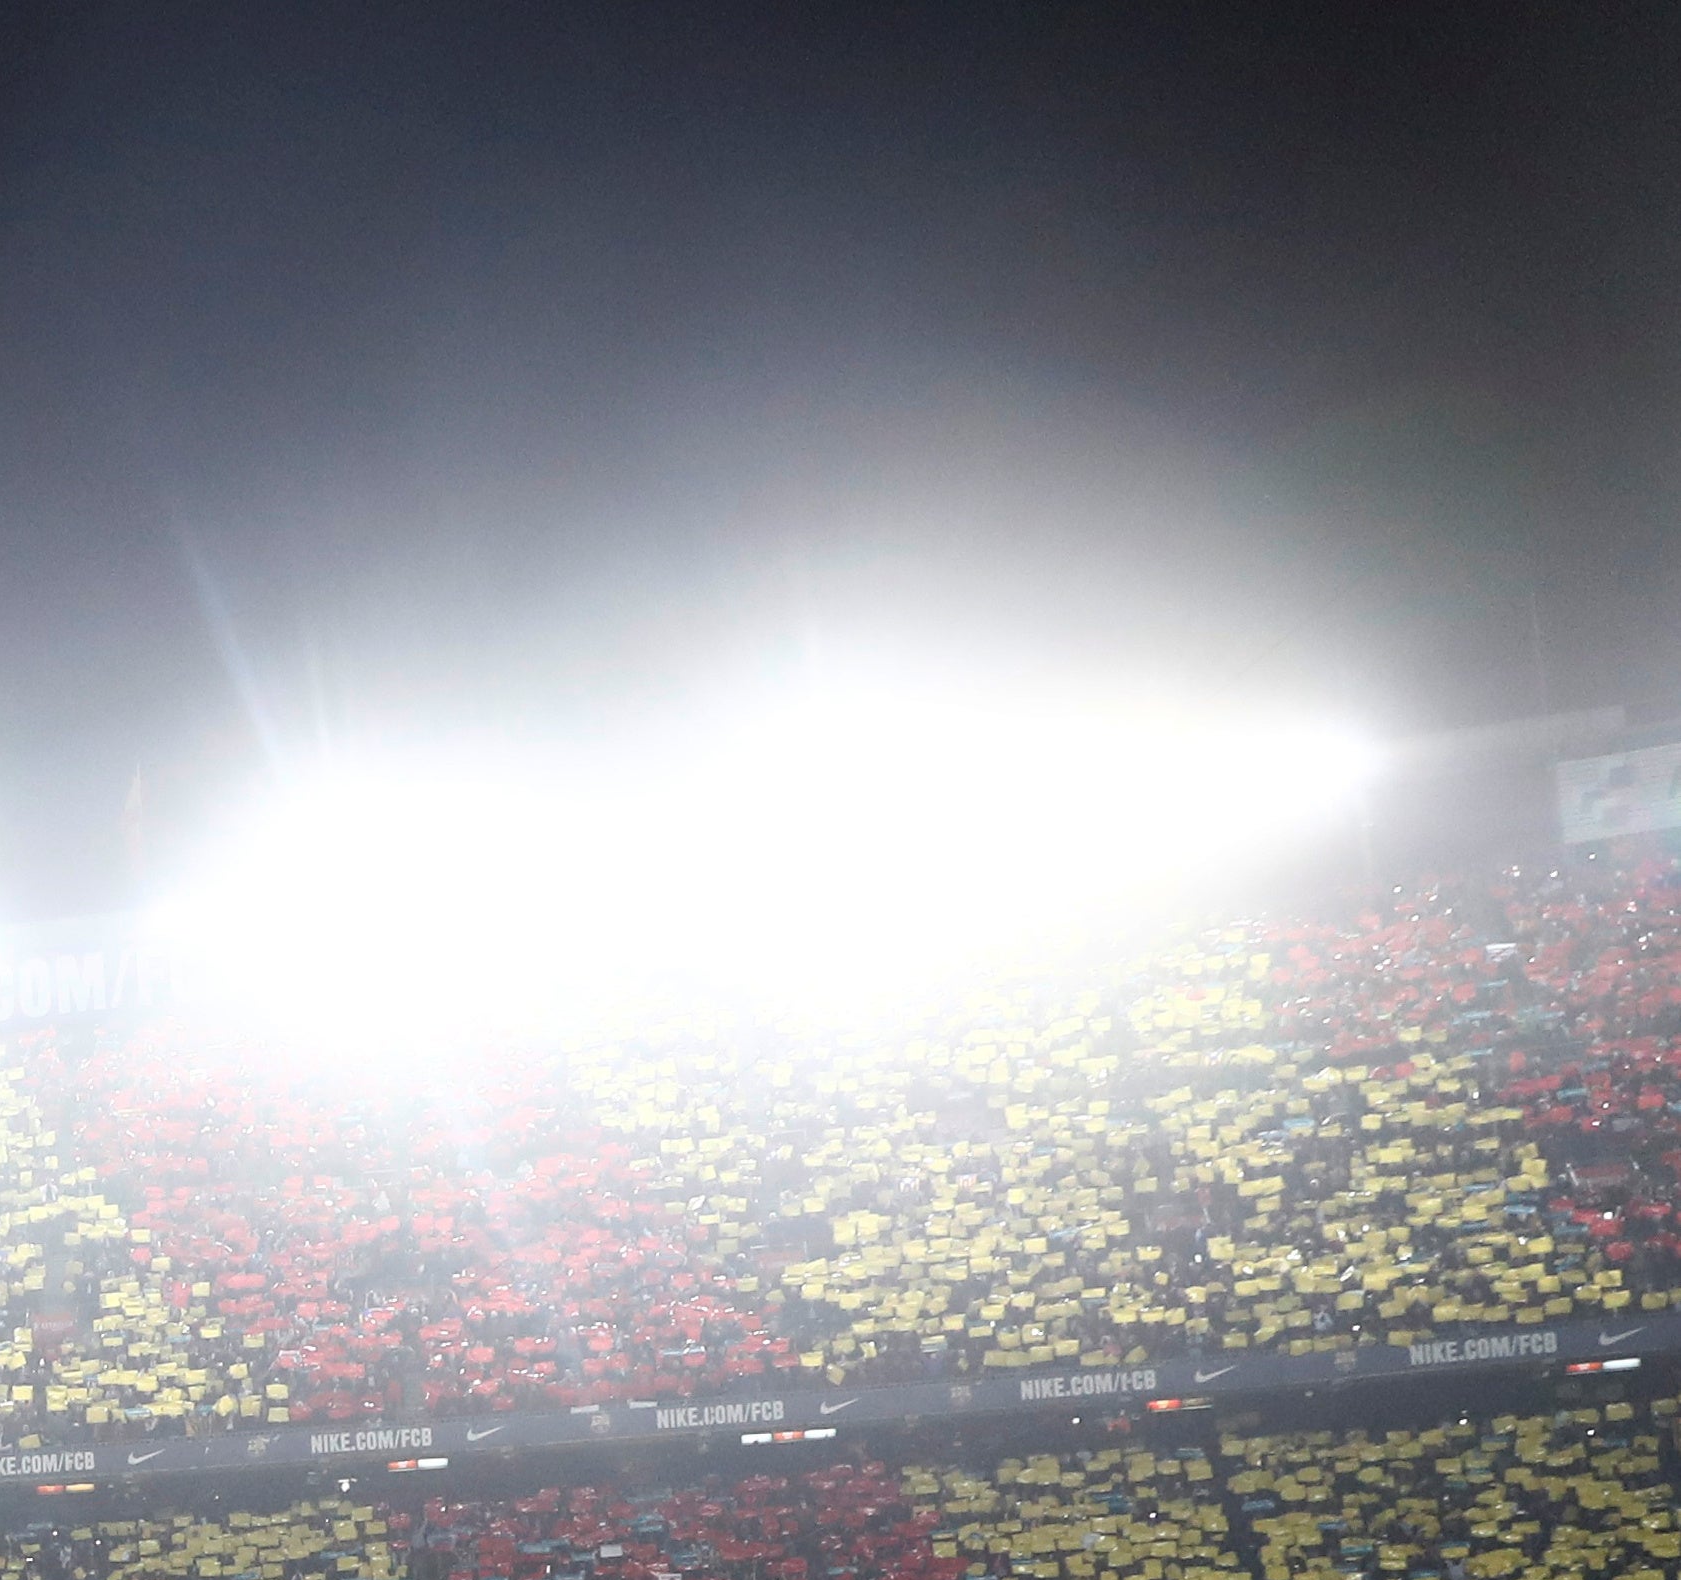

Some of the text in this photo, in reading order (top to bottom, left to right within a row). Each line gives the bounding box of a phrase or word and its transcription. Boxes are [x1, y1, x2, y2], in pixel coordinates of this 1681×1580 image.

[1409, 1335, 1557, 1365] NIKE.COM/FCB
[656, 1401, 785, 1429] NIKE.COM/FCB
[310, 1427, 433, 1454] NIKE.COM/FCB
